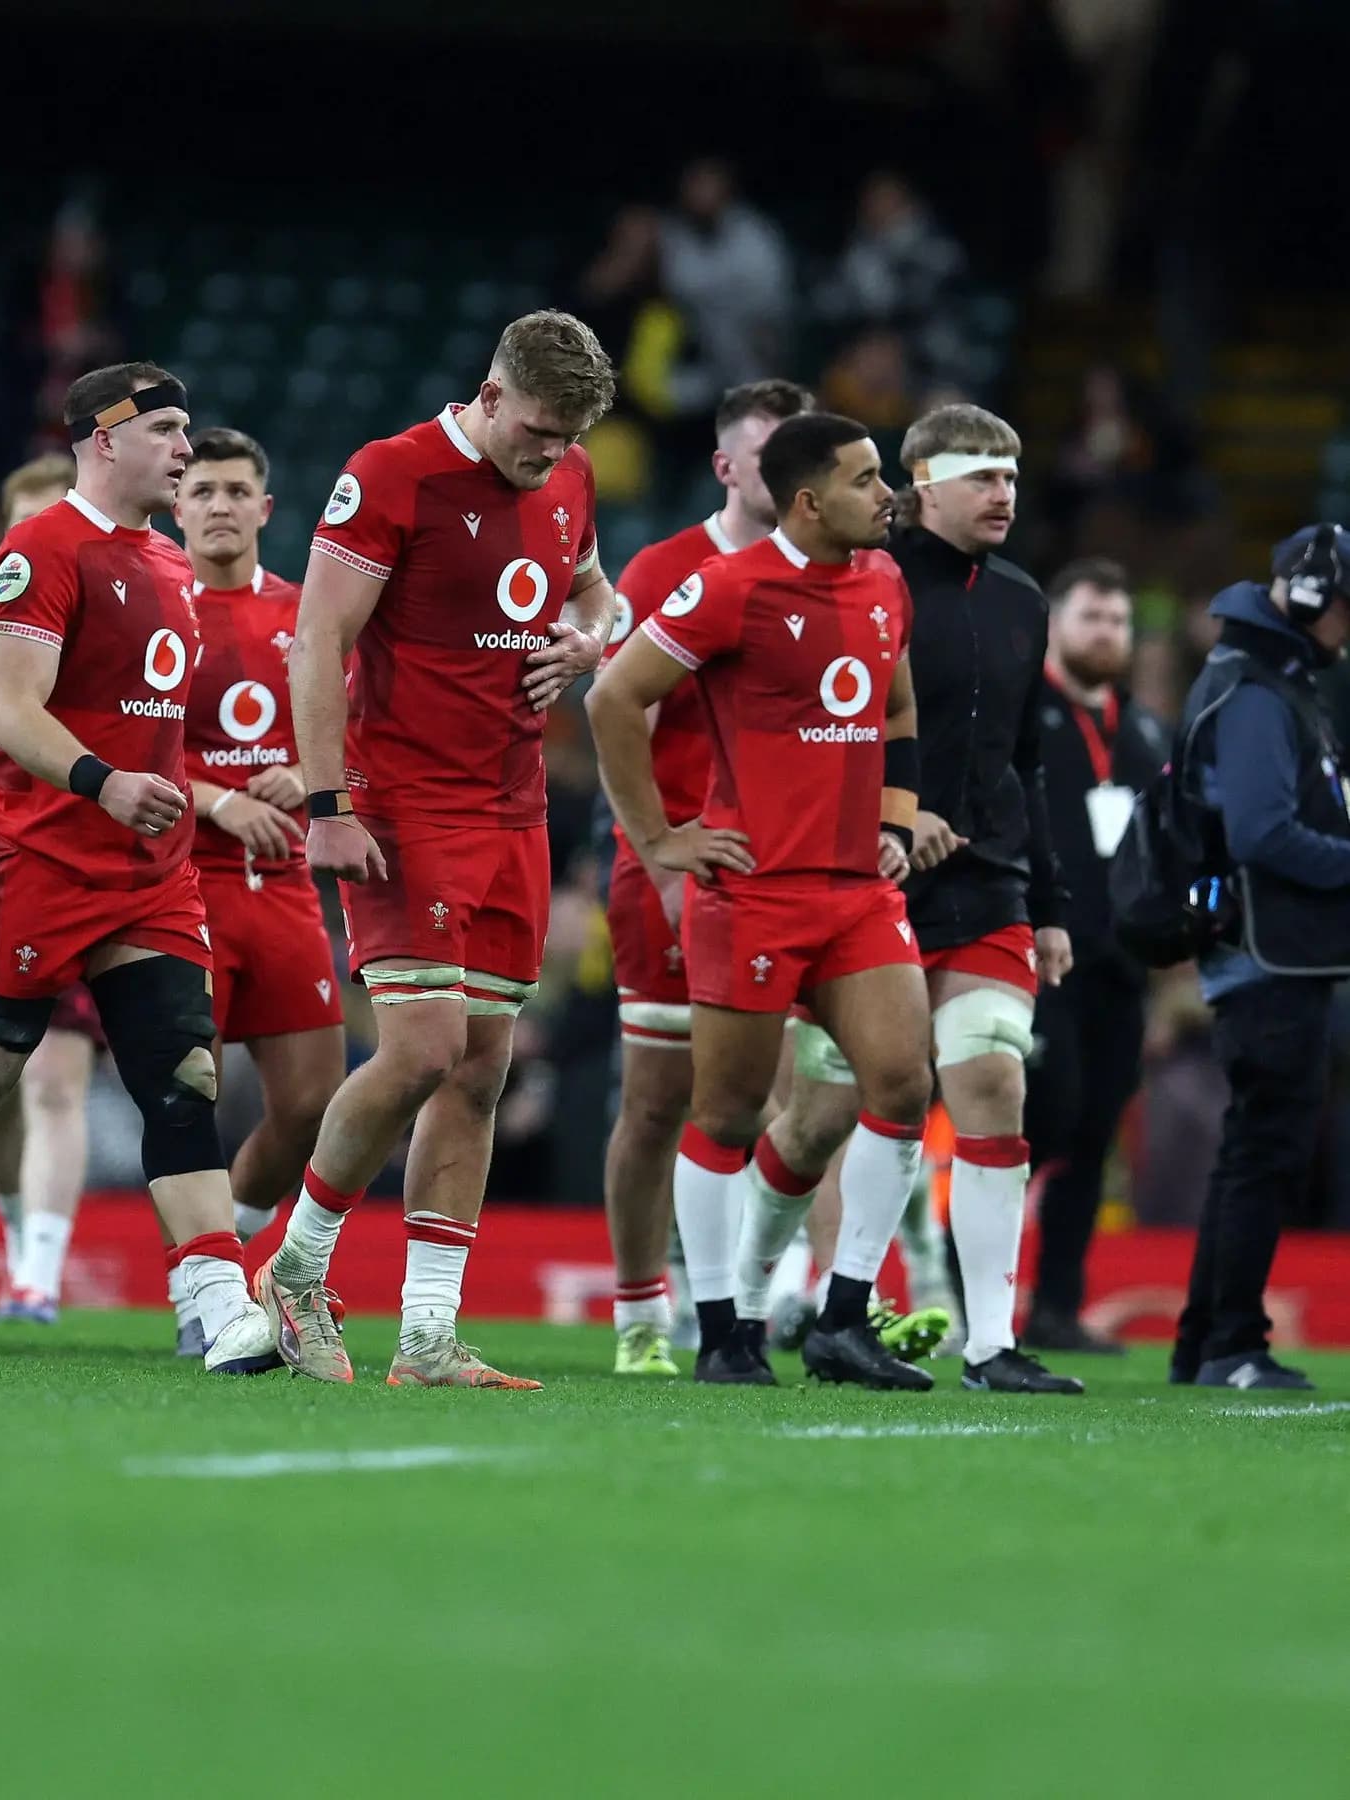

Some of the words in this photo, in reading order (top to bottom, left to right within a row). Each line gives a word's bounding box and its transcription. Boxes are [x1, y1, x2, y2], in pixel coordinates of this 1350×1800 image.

[473, 629, 550, 651] vodafone
[798, 722, 878, 743] vodafone
[201, 744, 288, 767] vodafone
